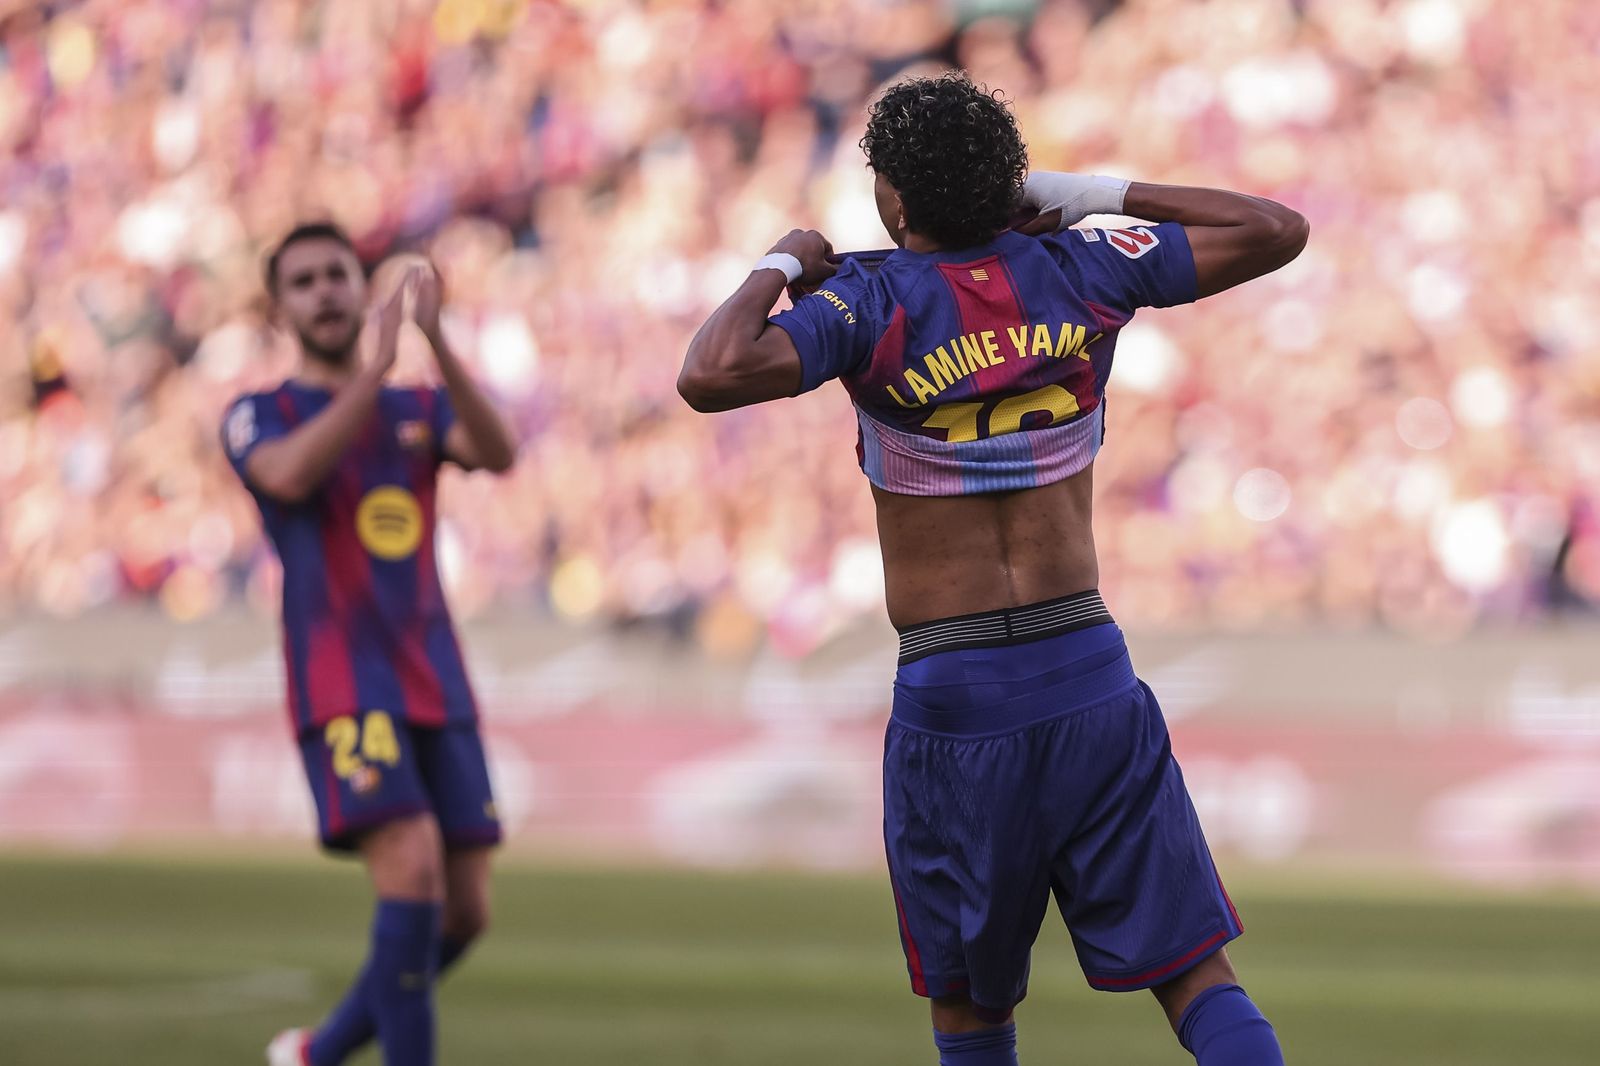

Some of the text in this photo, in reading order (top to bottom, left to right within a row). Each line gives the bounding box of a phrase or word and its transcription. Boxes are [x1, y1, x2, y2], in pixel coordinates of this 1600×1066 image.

[844, 312, 856, 324] tv
[886, 330, 1006, 408] LAMINE
[325, 709, 401, 780] 24
